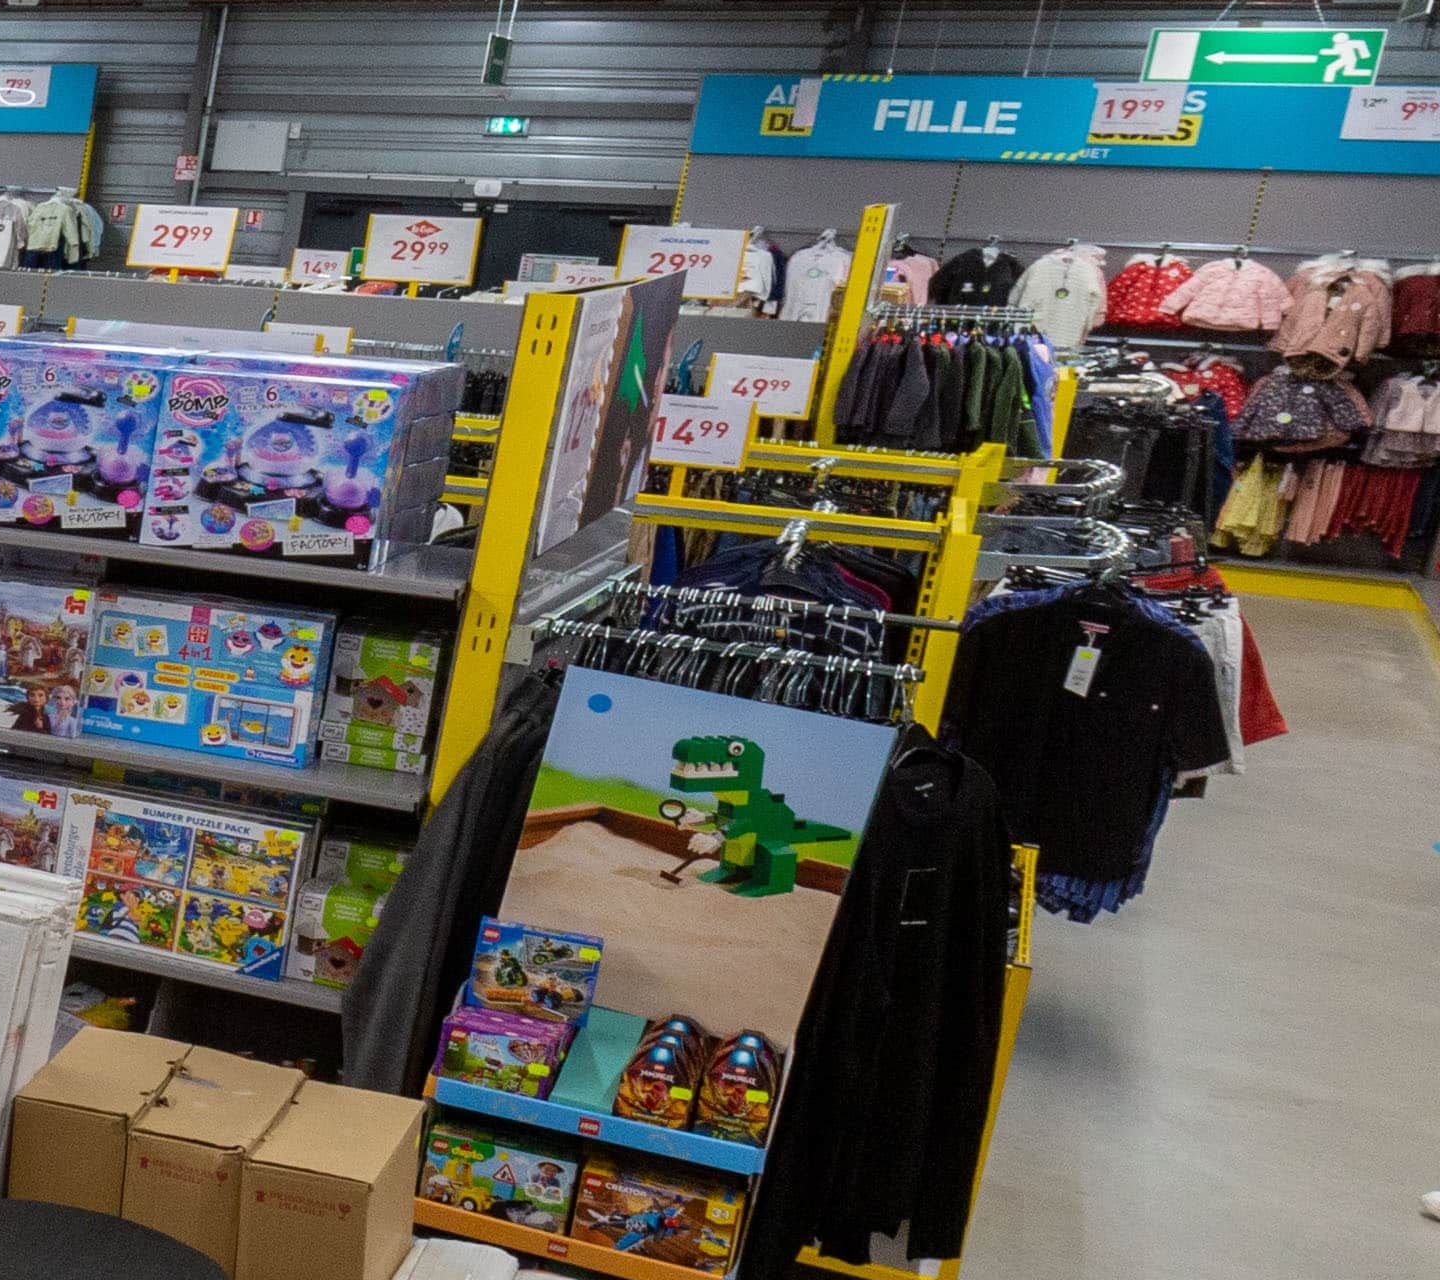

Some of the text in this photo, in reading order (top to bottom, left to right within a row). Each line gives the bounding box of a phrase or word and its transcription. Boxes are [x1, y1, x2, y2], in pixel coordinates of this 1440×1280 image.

[873, 99, 1022, 135] FILLE
[1103, 99, 1166, 121] 1999
[1400, 102, 1440, 121] 999
[150, 224, 214, 249] 2999
[391, 239, 449, 262] 2999
[302, 260, 338, 276] 1499
[648, 250, 714, 274] 2999
[44, 368, 56, 384] 6
[266, 385, 278, 402] 6
[730, 377, 791, 399] 4999
[654, 415, 730, 446] 1499
[142, 806, 251, 837] BUMPER PUZZLE PACK
